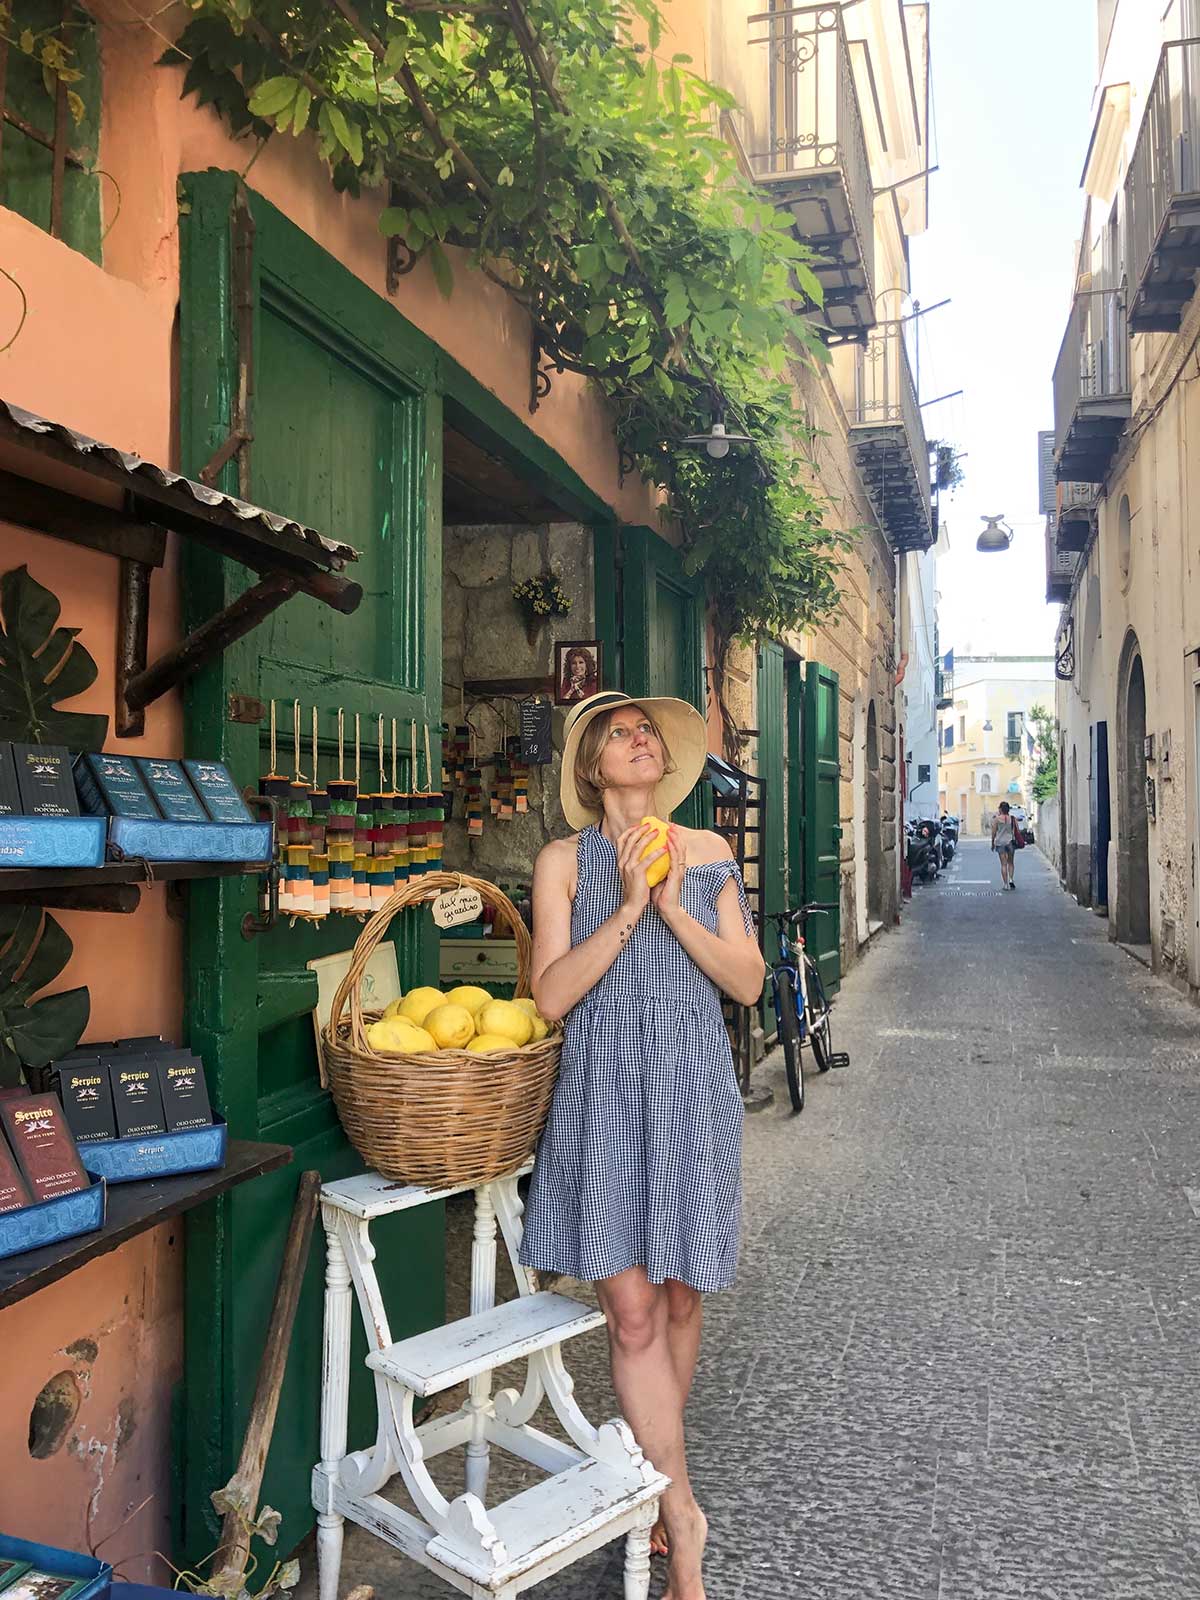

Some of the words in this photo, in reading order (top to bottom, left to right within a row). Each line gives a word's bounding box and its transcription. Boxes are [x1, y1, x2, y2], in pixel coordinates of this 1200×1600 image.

[25, 753, 61, 765] Serpico
[0, 846, 25, 857] Serpi
[119, 1070, 150, 1084] Serpico
[167, 1065, 197, 1080] Serpico
[70, 1075, 102, 1089] Serpico
[14, 1107, 54, 1126] Serpico
[36, 1174, 56, 1184] BAGNO
[56, 1170, 78, 1179] DOCCIA
